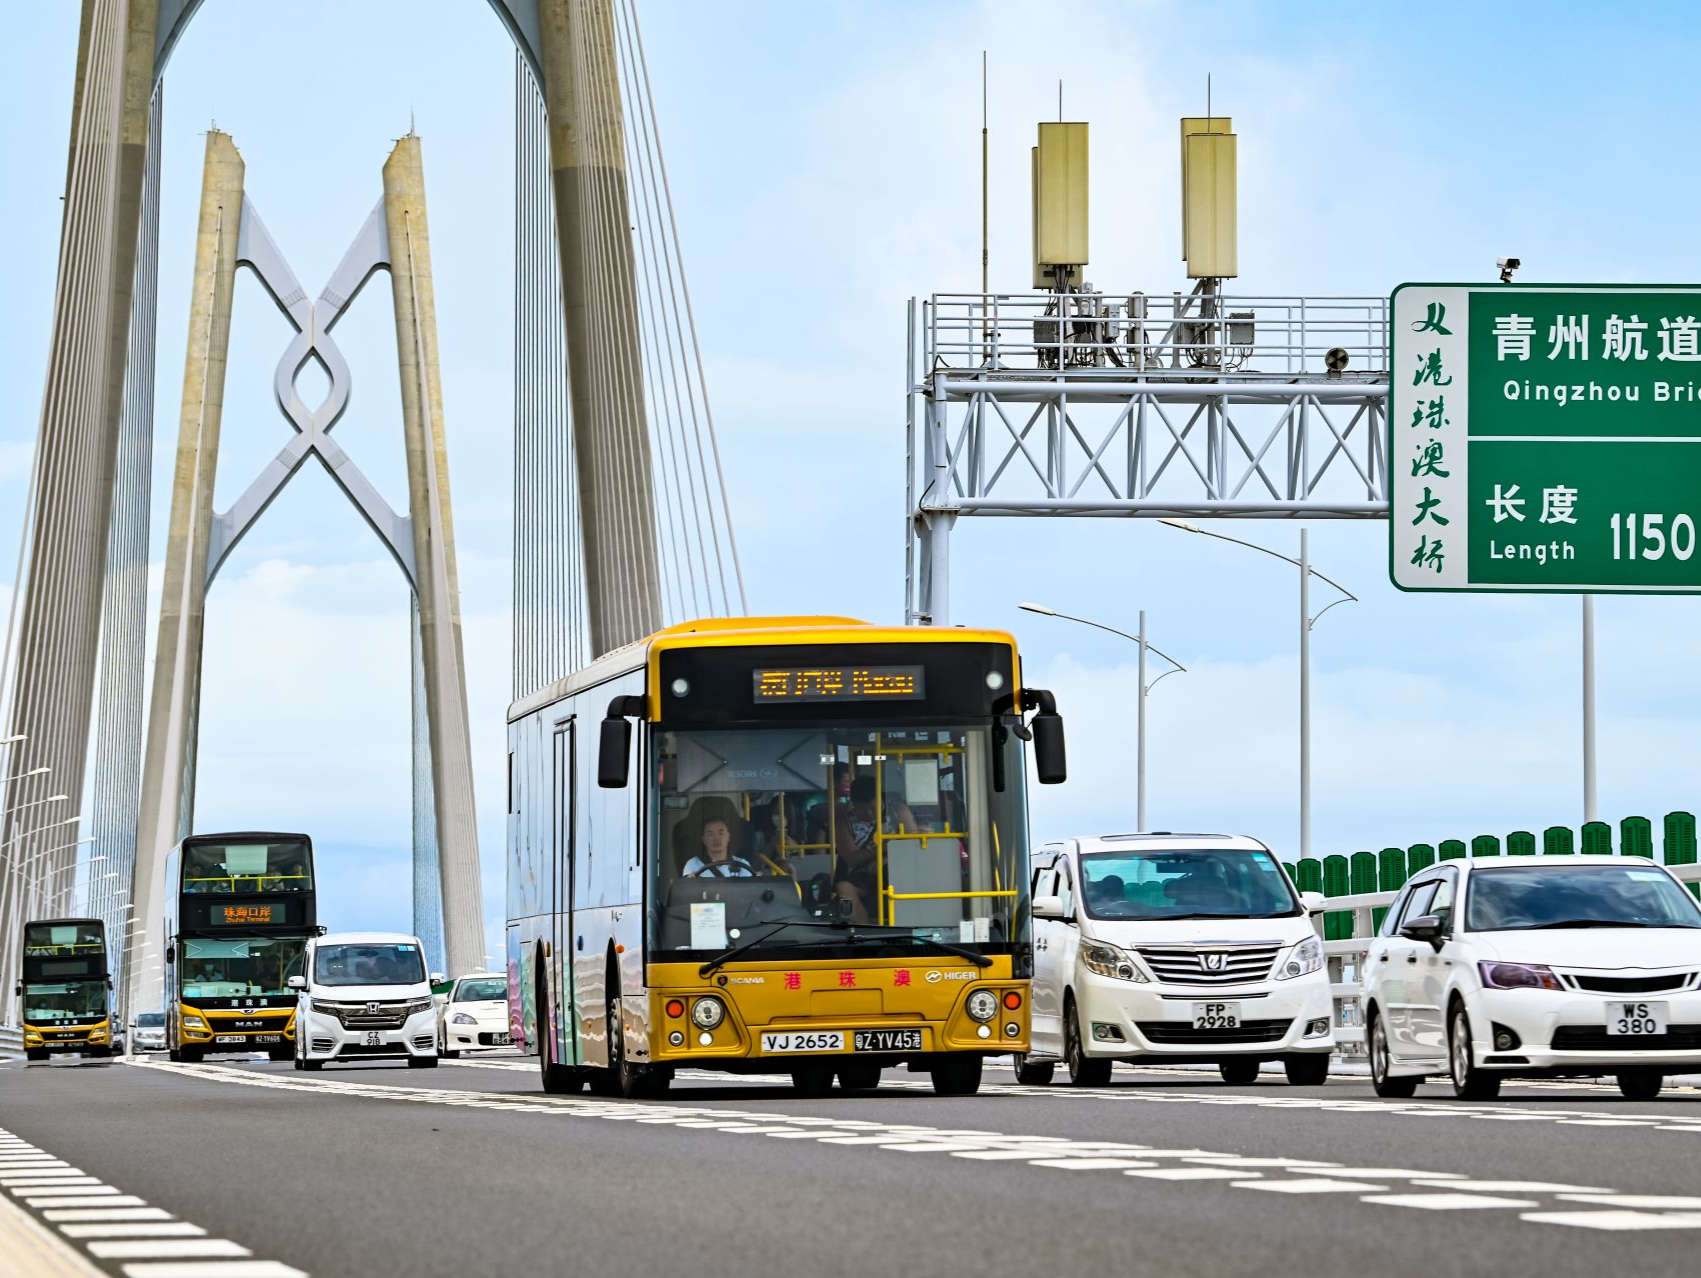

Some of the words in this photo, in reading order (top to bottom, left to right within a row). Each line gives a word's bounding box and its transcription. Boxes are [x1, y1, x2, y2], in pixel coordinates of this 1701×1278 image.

[1492, 313, 1701, 362] 青州航道
[1503, 380, 1639, 406] Qingzhou
[1654, 381, 1701, 402] Bri
[1485, 484, 1578, 525] 长度
[1610, 513, 1696, 561] 1150
[1490, 540, 1575, 565] Length
[784, 970, 911, 990] 港珠澳
[944, 971, 977, 980] HIGER
[1206, 1003, 1225, 1016] FP
[1623, 1004, 1649, 1018] WS
[1197, 1016, 1236, 1028] 2928
[1617, 1018, 1656, 1034] 380
[767, 1036, 789, 1050] VJ
[795, 1034, 840, 1049] 2652
